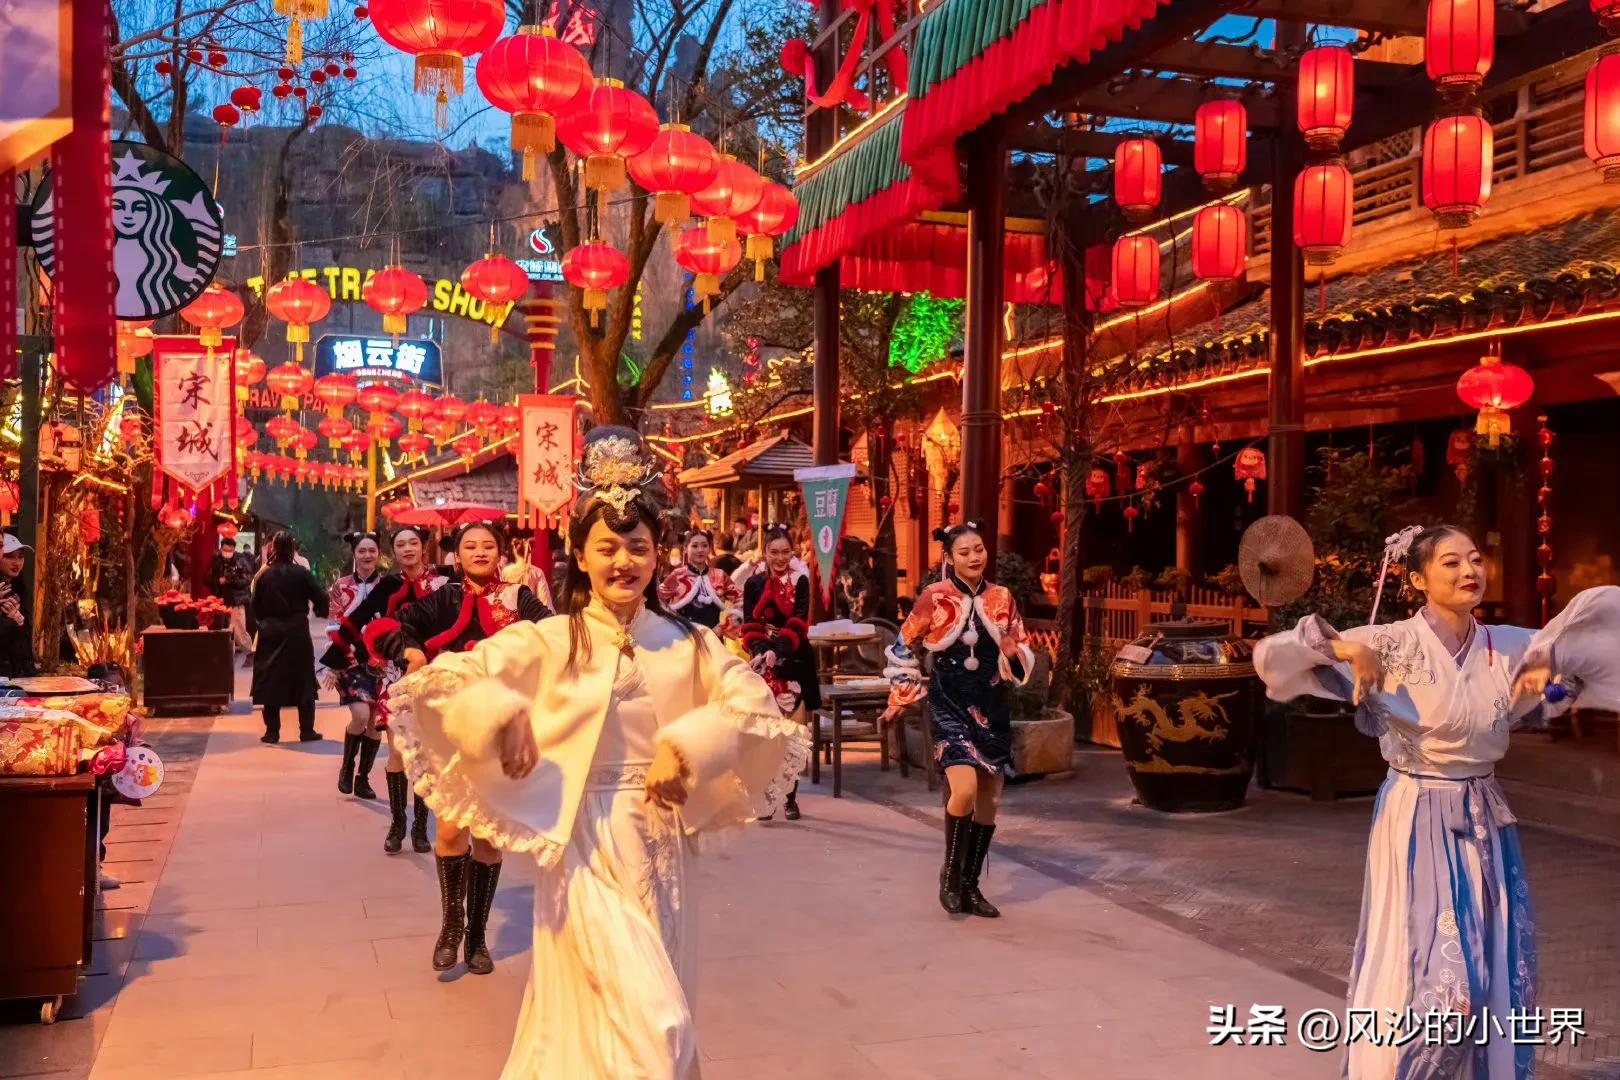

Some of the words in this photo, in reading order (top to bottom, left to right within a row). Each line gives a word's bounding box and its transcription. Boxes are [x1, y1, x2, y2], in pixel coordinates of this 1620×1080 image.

[333, 340, 427, 374] 烟云街
[176, 370, 219, 461] 宋城
[533, 421, 562, 491] 宋城
